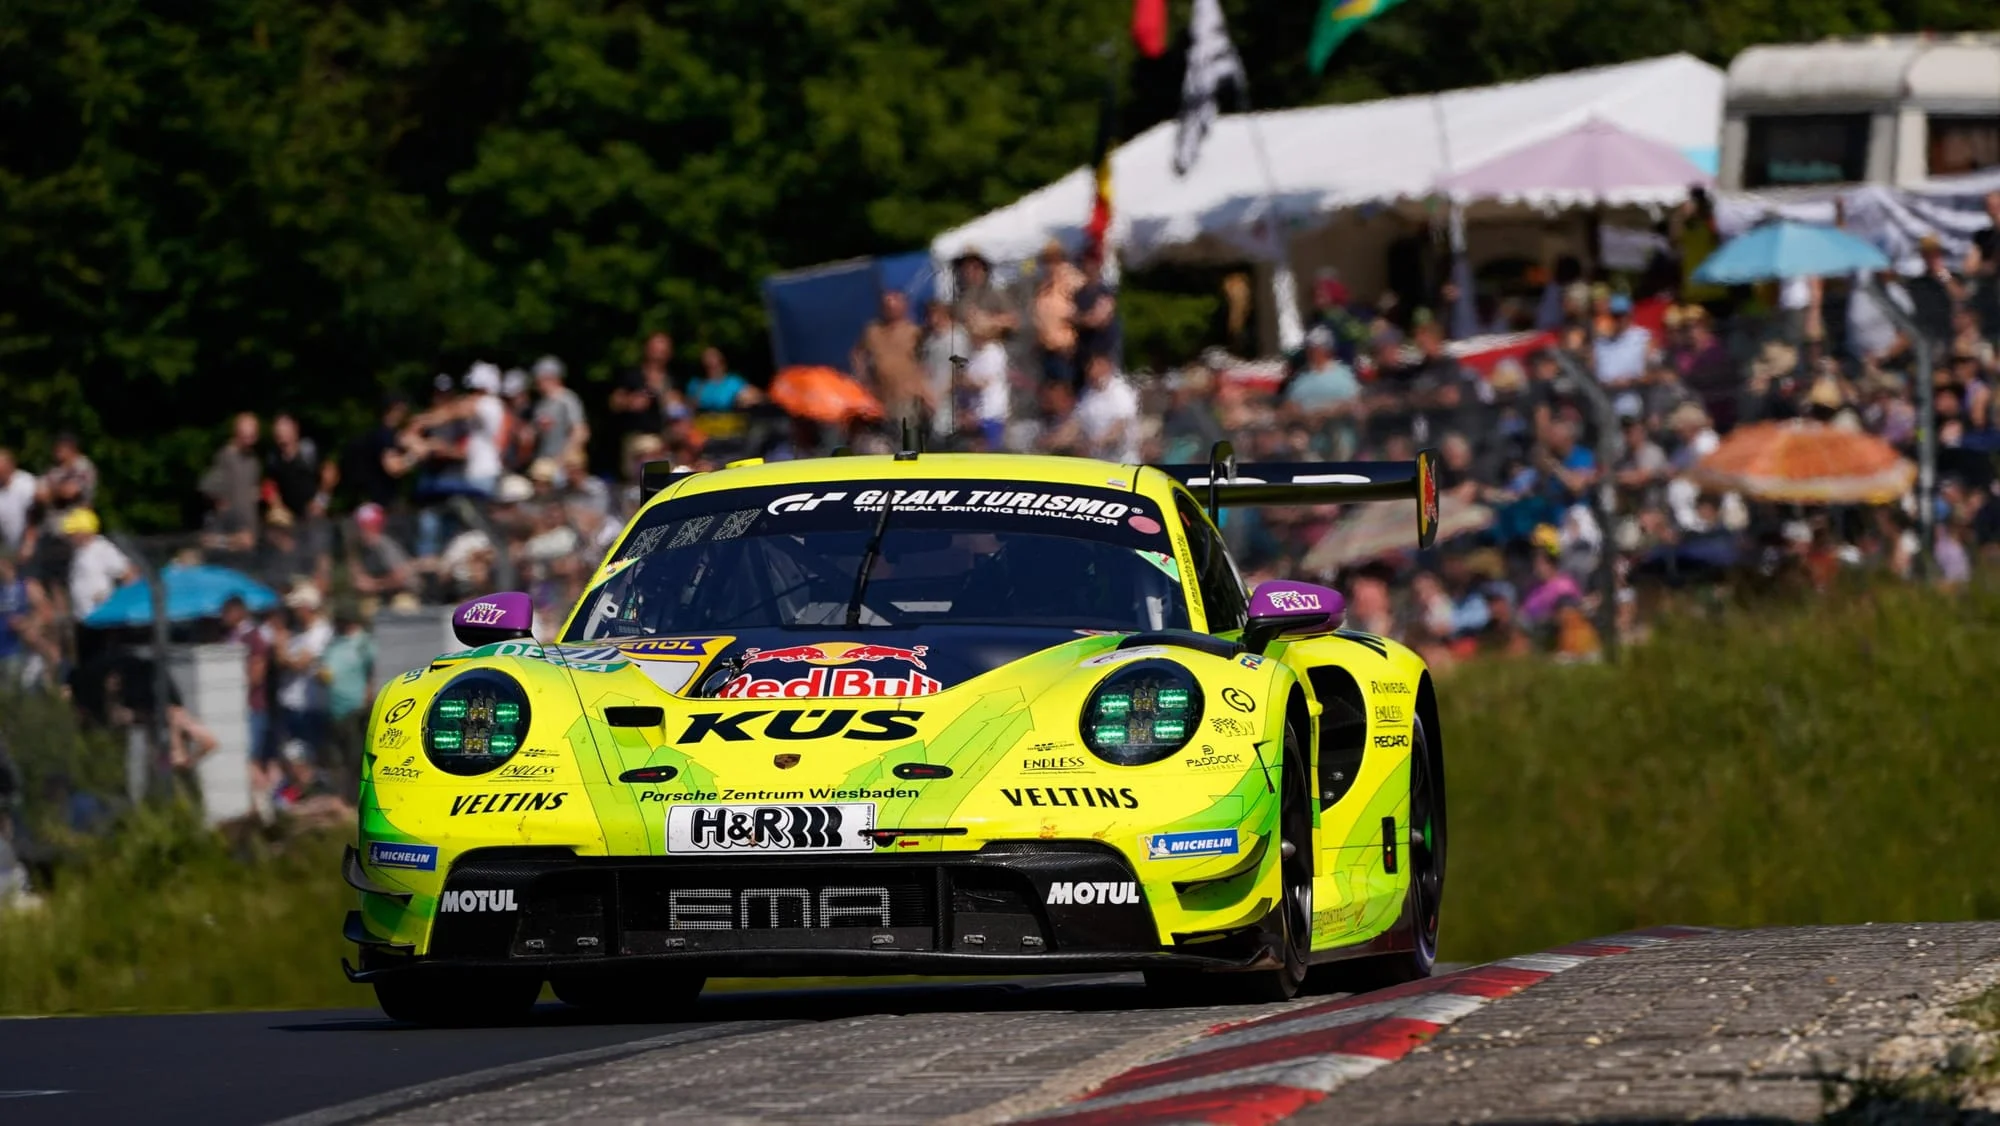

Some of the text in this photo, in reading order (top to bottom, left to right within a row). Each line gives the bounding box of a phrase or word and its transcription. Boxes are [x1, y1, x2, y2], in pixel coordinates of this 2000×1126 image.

[853, 489, 1129, 519] GRAN TURISMO
[941, 504, 1014, 515] DRIVING
[1015, 507, 1119, 526] SIMULATOR
[1280, 593, 1322, 612] KW
[465, 605, 507, 625] KW
[716, 667, 944, 699] Red Bull
[675, 709, 926, 746] KÜS
[1374, 735, 1410, 748] RECARO
[498, 764, 560, 776] ENDLESS
[1023, 756, 1086, 769] ENDLESS
[1185, 754, 1243, 767] PADDOCK
[449, 791, 569, 817] VELTINS
[640, 786, 920, 803] Porsche Zentrum Wiesbaden
[1000, 787, 1140, 810] VELTINS
[1170, 836, 1234, 852] MICHELIN
[379, 850, 431, 864] MICHELIN
[440, 888, 519, 914] MOTUL
[1046, 881, 1140, 905] MOTUL
[668, 886, 892, 931] EMA
